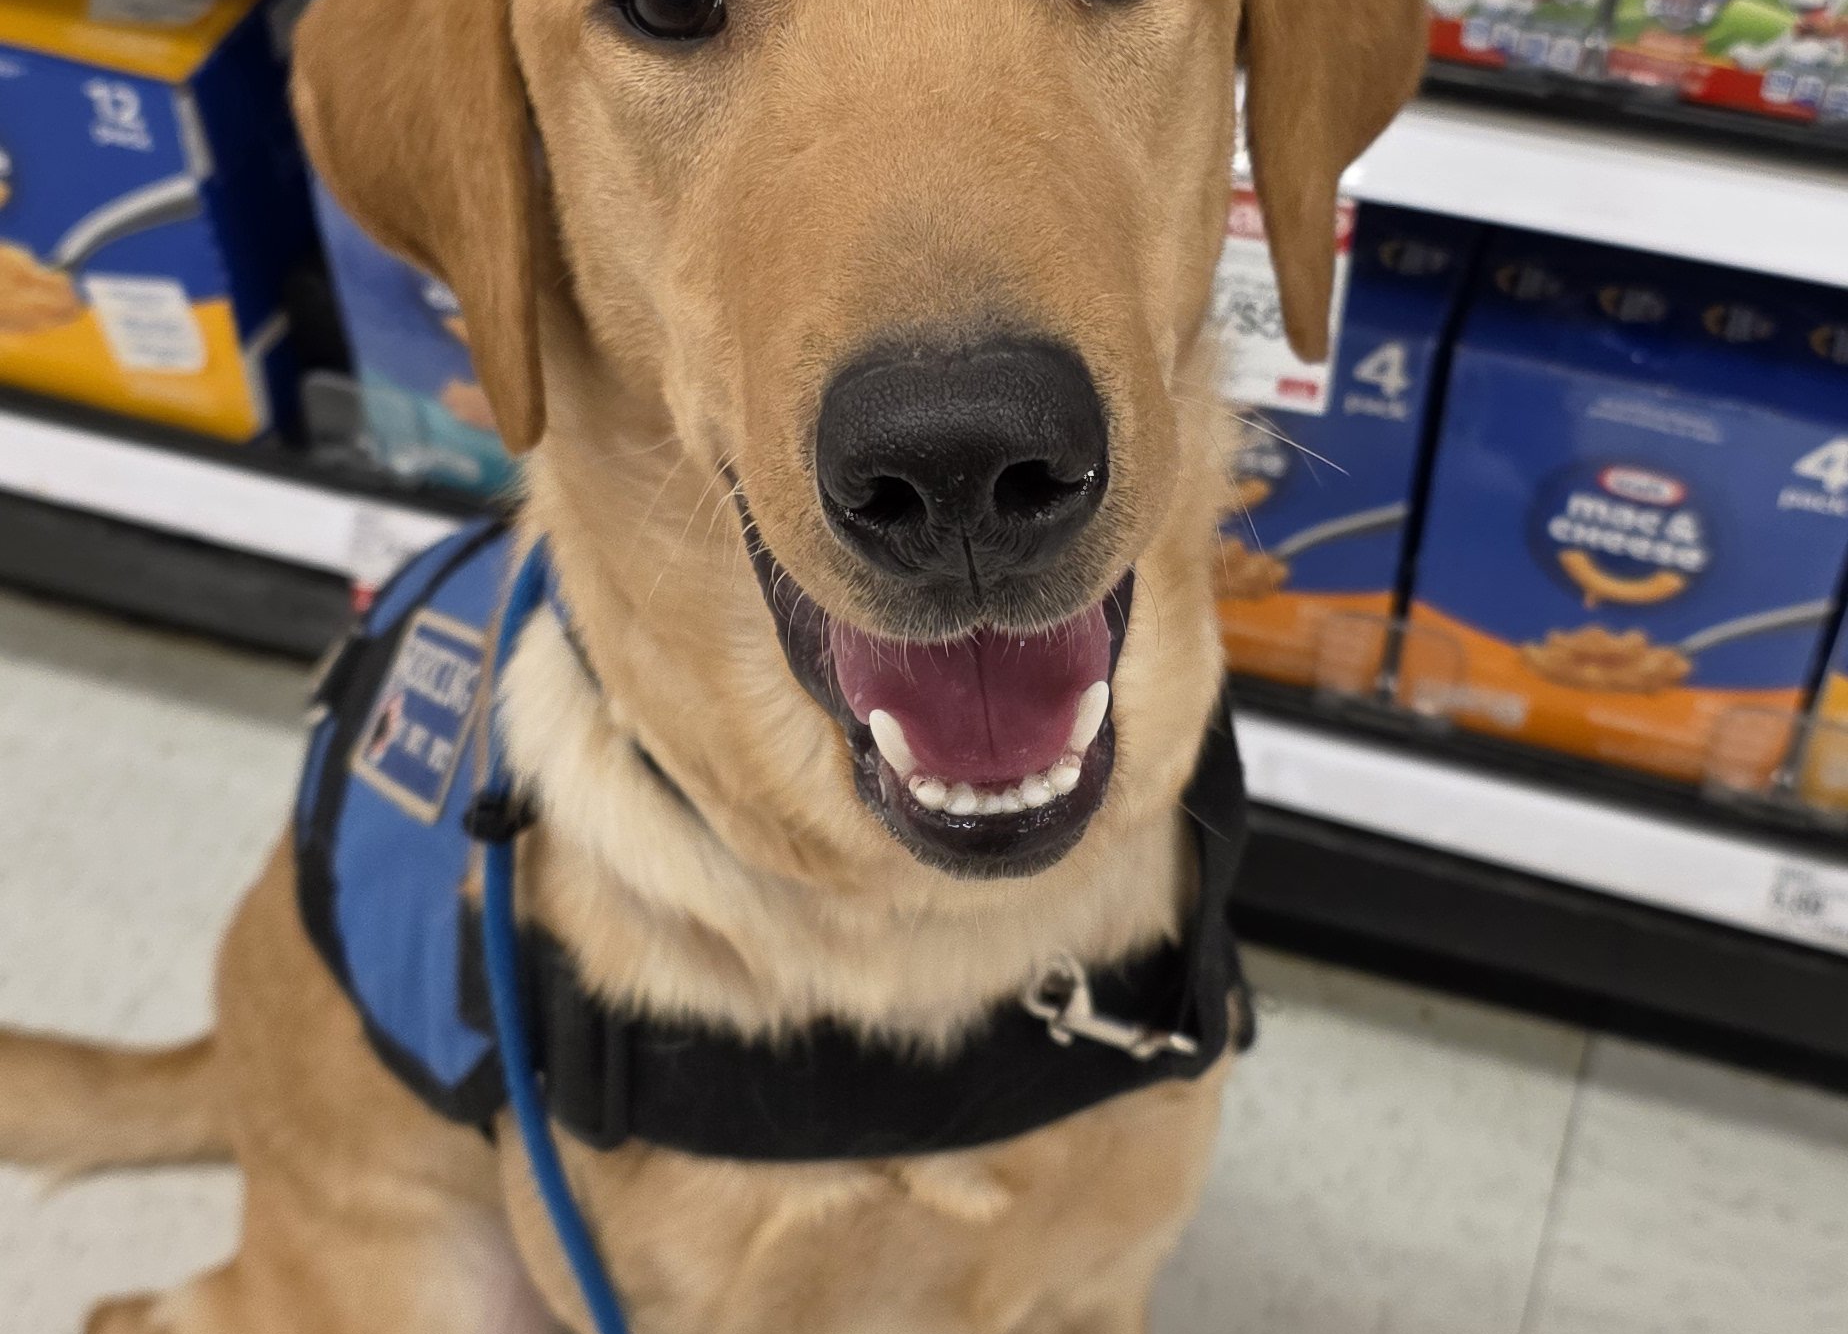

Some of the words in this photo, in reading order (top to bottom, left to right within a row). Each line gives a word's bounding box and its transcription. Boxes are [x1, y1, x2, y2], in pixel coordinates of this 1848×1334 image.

[1353, 340, 1411, 398] 4
[1792, 437, 1848, 494] 4
[1567, 492, 1661, 536] mac
